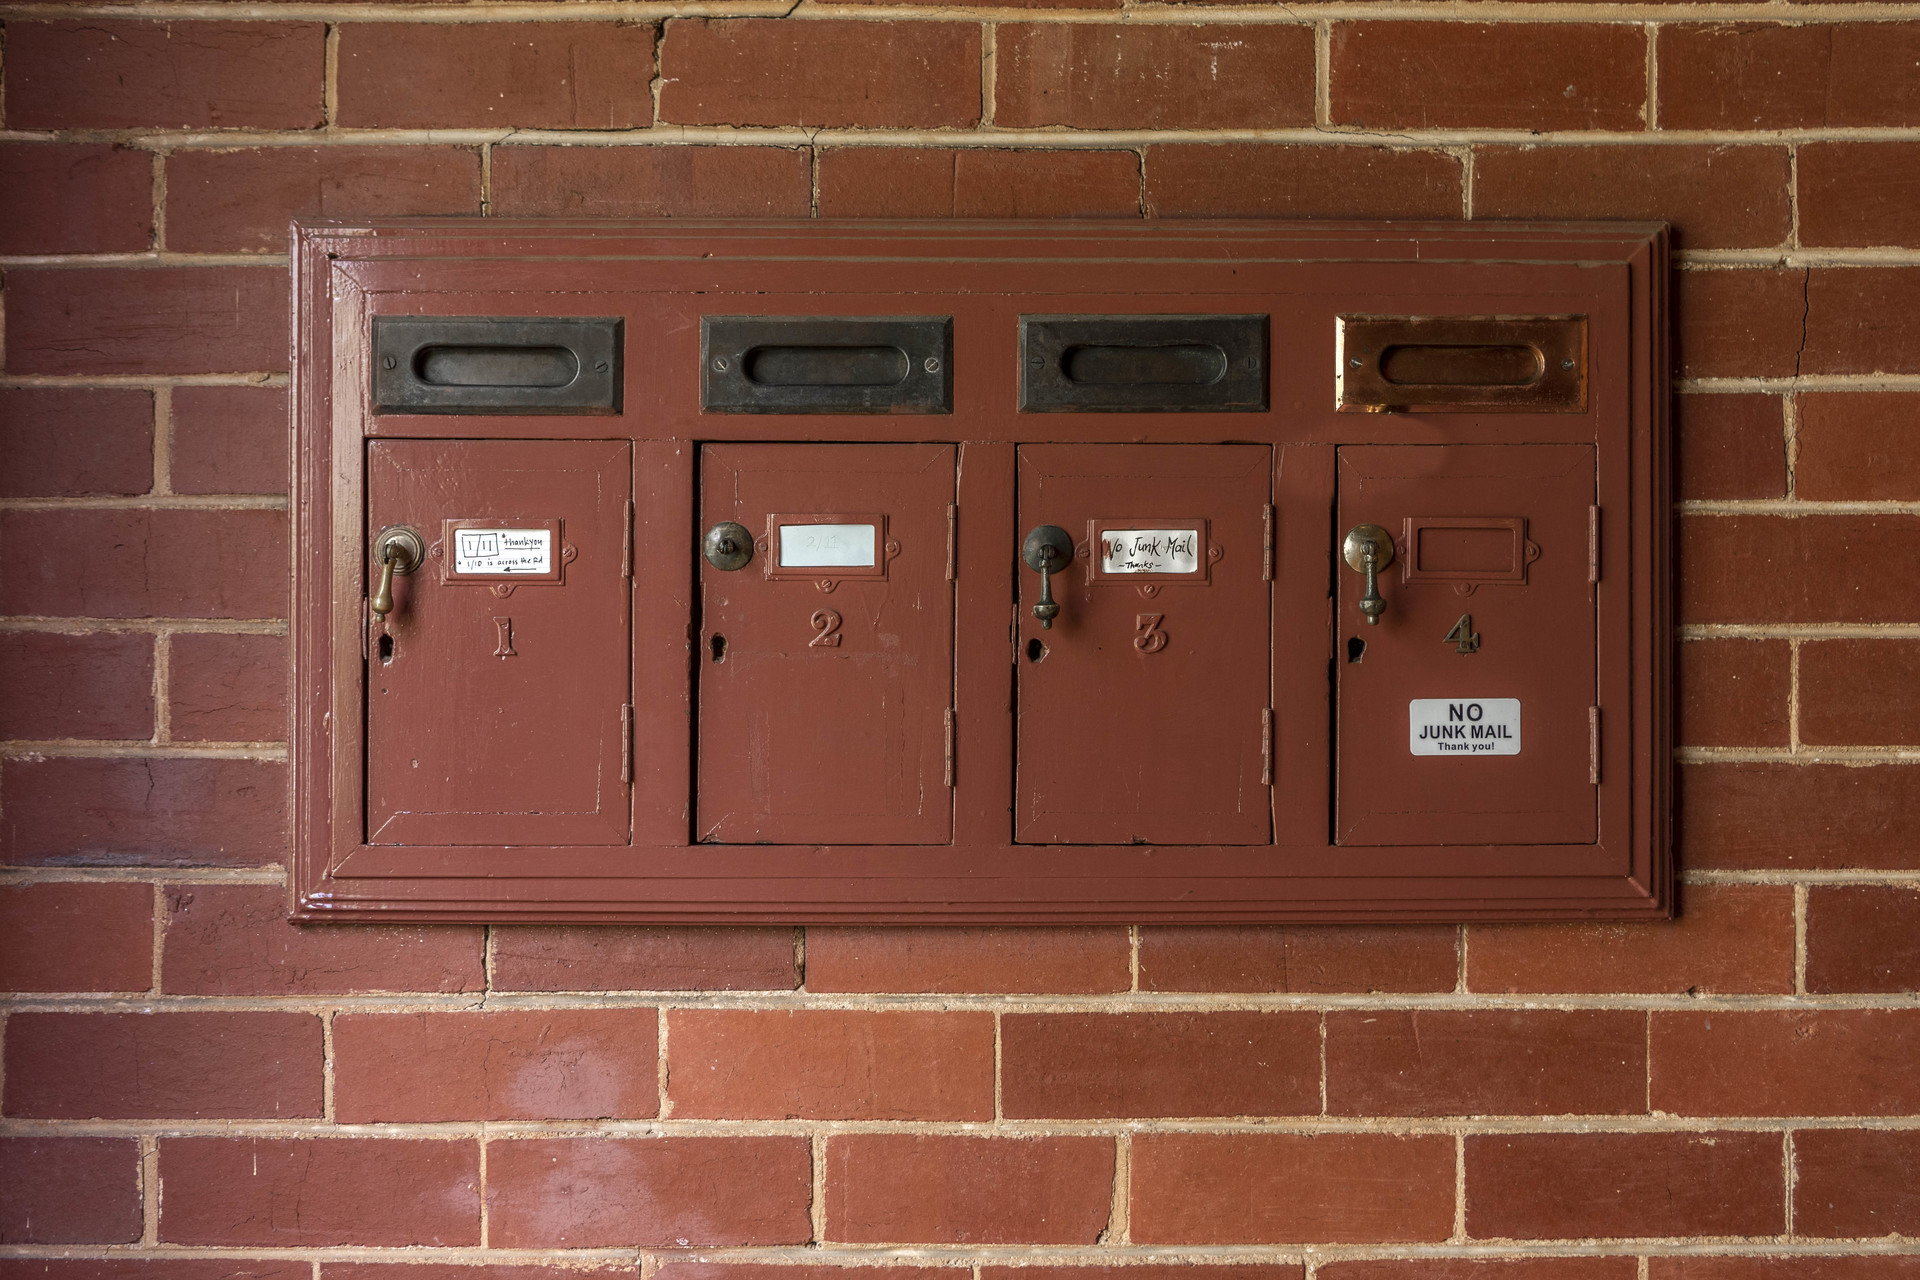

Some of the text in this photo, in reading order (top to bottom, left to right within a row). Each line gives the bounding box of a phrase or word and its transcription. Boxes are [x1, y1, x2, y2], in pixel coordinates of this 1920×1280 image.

[1129, 536, 1161, 558] Junk
[1165, 534, 1193, 560] Mail
[487, 558, 493, 566] is
[520, 557, 531, 565] the
[493, 616, 517, 656] 1
[808, 608, 842, 647] 2
[1133, 613, 1168, 654] 3
[1442, 614, 1480, 653] 4
[1449, 703, 1483, 722] NO
[1419, 725, 1512, 739] JUNK MAIL
[1438, 742, 1494, 752] Thank you!
